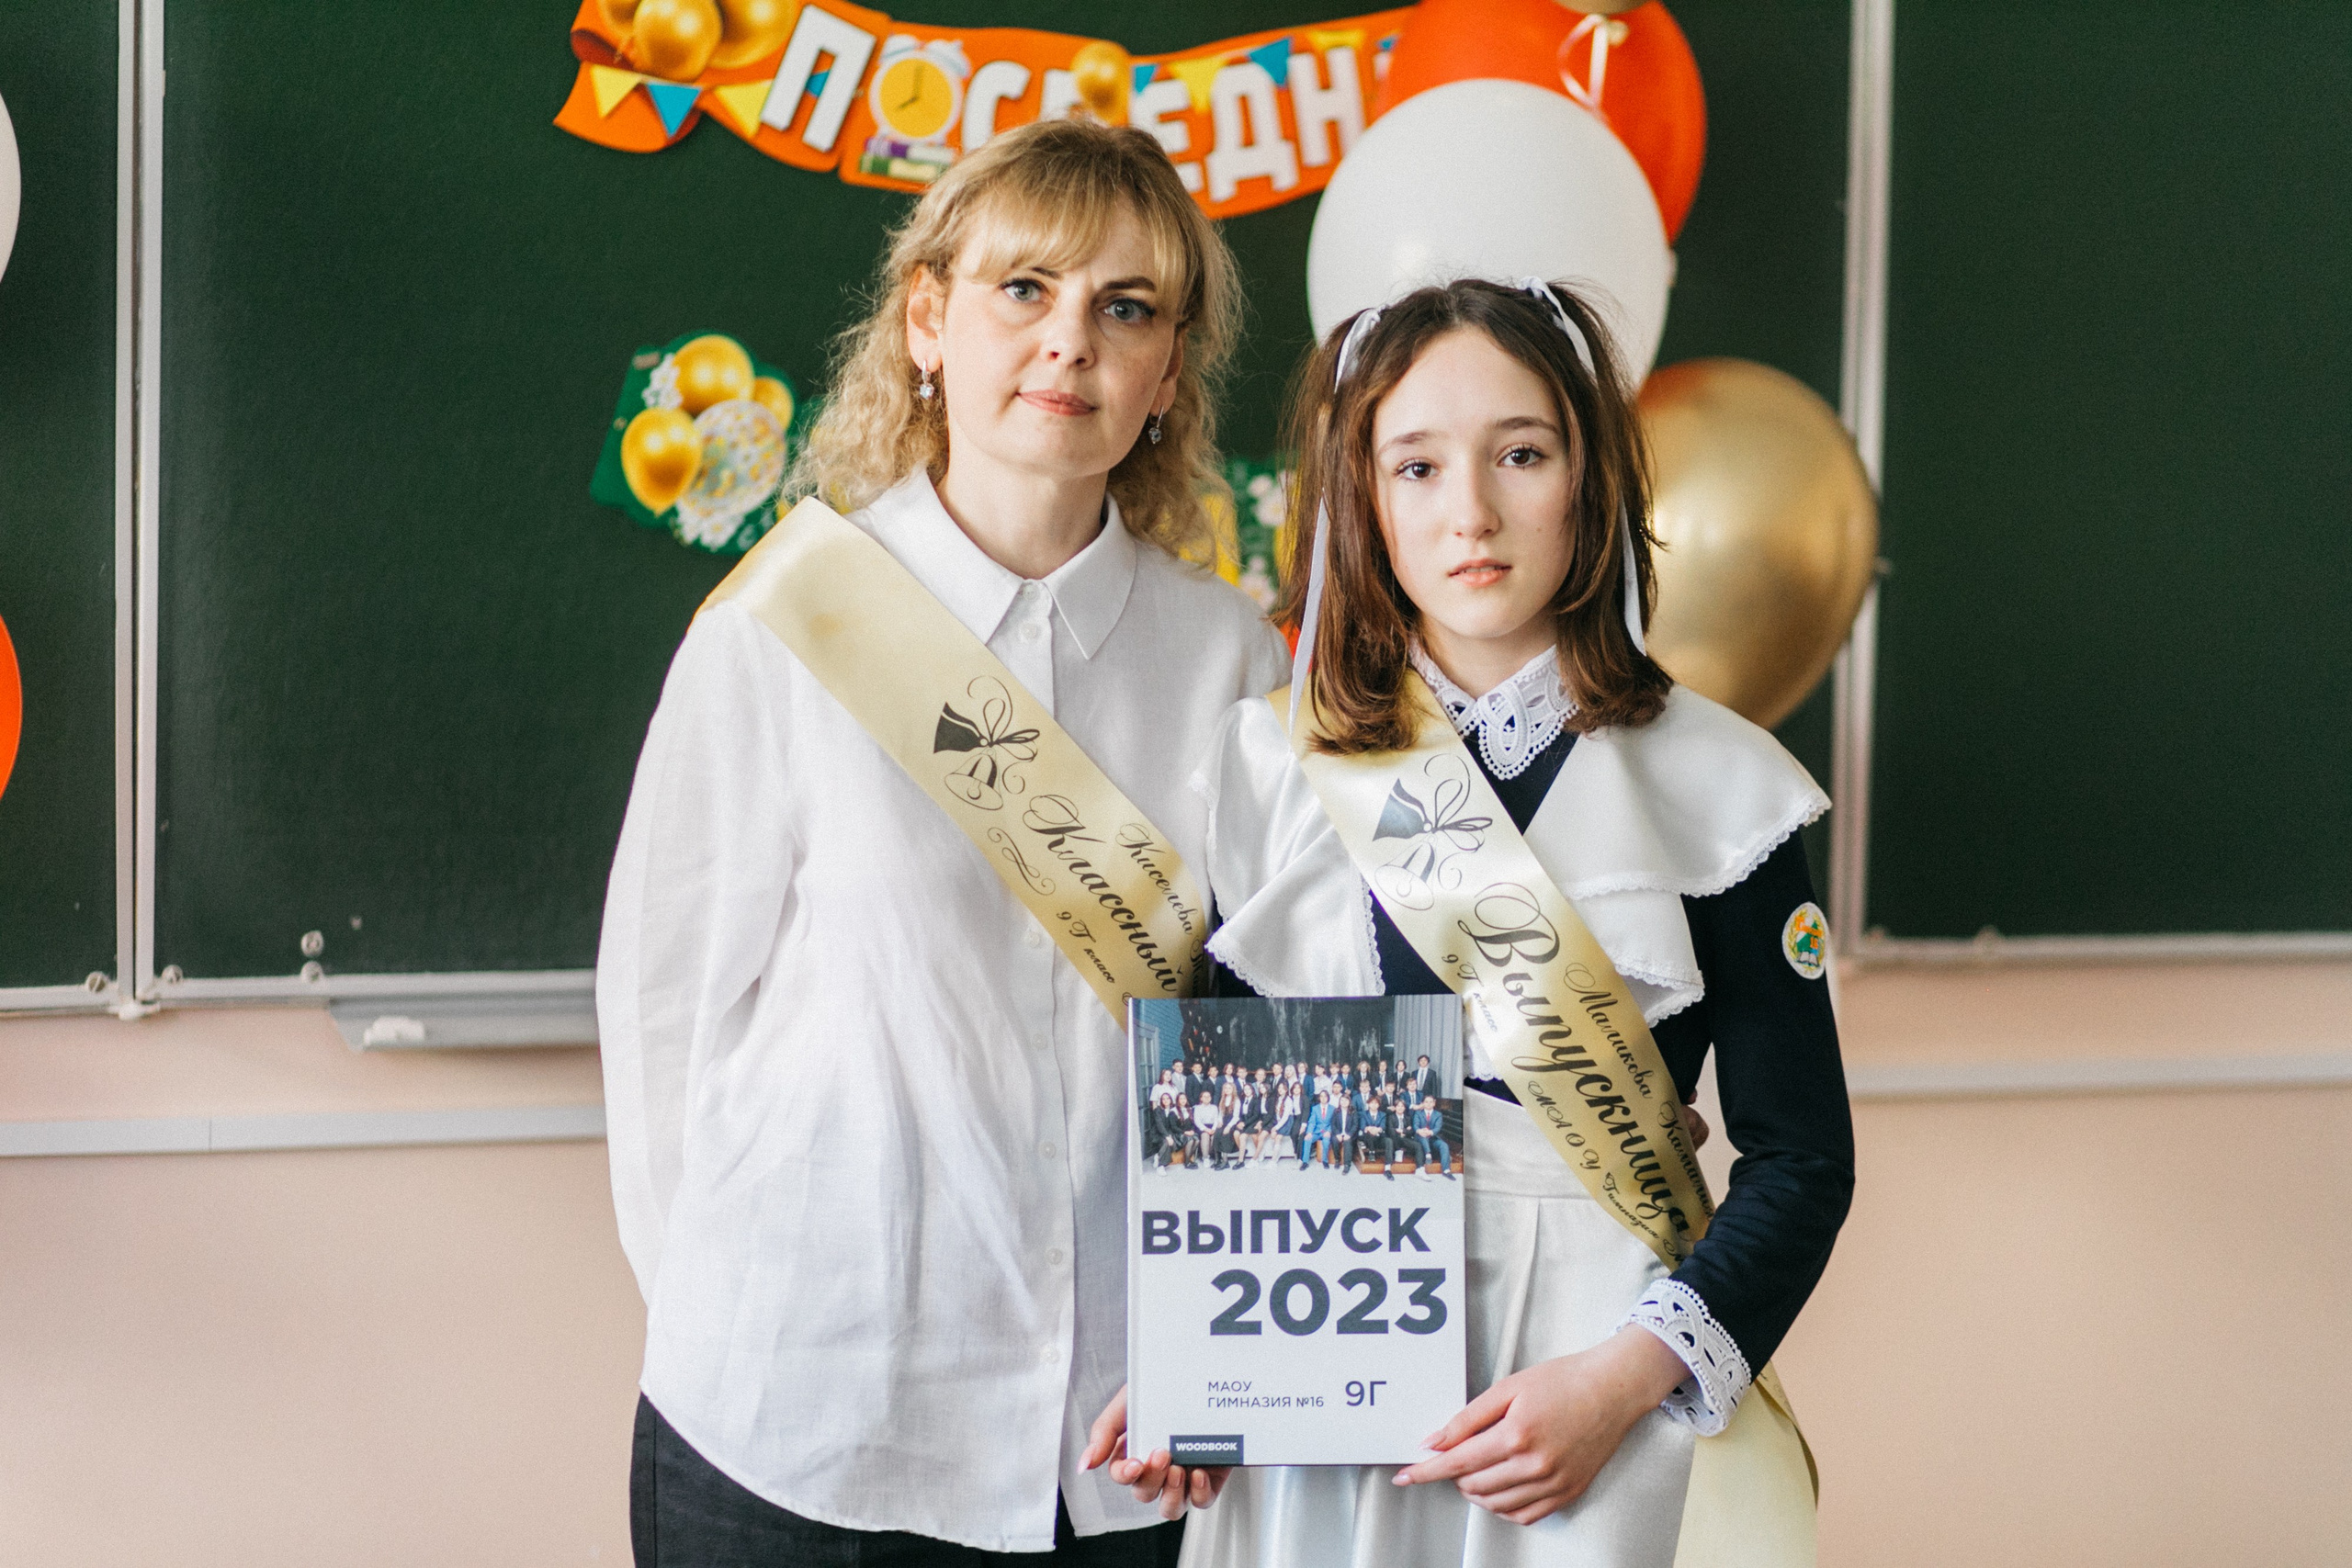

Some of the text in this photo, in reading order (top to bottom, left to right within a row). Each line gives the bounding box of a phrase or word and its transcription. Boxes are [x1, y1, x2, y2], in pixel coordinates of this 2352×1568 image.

[1023, 794, 1184, 992] Классный
[1115, 823, 1198, 935] Киселева
[1083, 948, 1115, 984] класс
[1473, 992, 1498, 1034] класс
[1564, 962, 1654, 1100] Маликова
[1457, 882, 1690, 1242] Выпускница
[1142, 1207, 1431, 1255] ВЫПУСК
[1210, 1268, 1448, 1337] 2023
[1207, 1395, 1324, 1408] ГИМНАЗИЯ №16
[1208, 1381, 1252, 1392] МАОУ
[1345, 1380, 1387, 1407] 9Г
[1176, 1442, 1238, 1451] WOODBOOK
